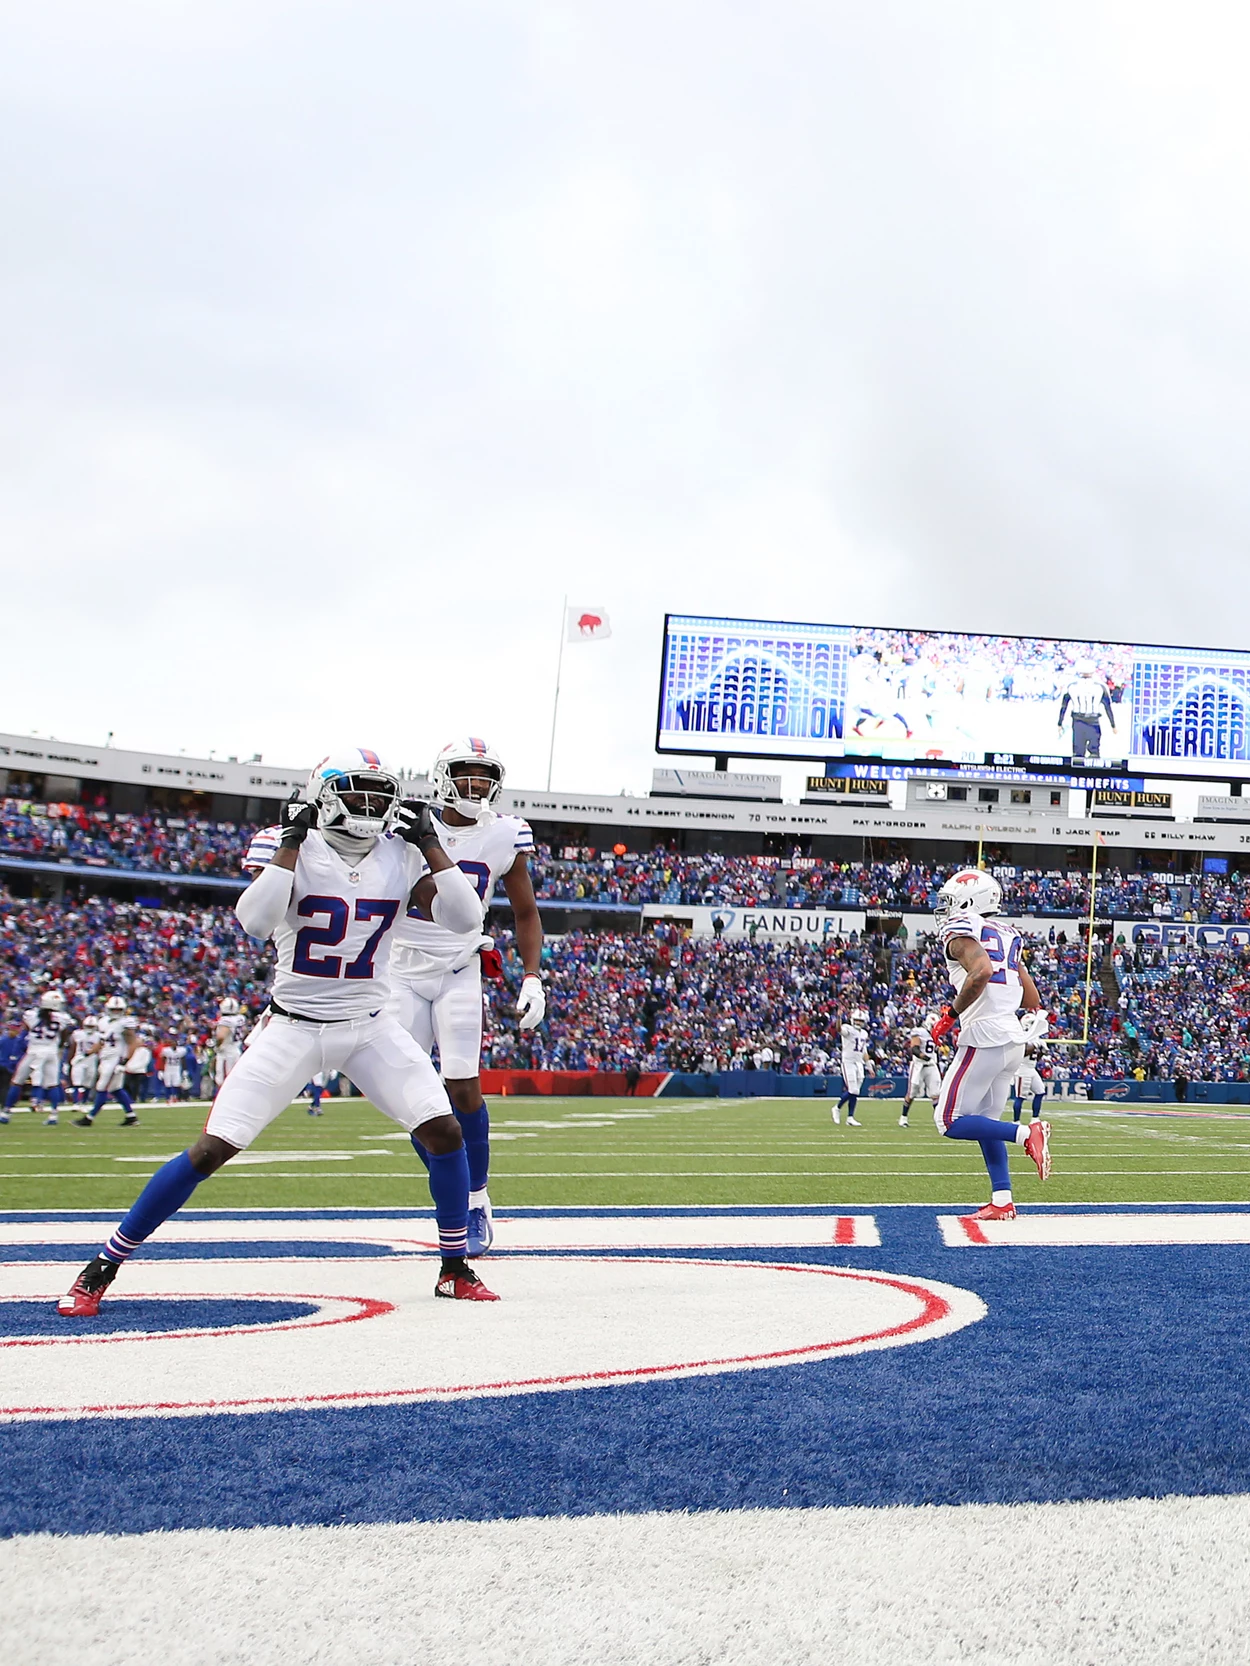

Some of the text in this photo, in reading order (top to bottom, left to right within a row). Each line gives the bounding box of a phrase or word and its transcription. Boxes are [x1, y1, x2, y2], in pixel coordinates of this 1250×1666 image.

[688, 771, 779, 783] IMAGINE STAFFING
[810, 778, 885, 790] HUNT HUNT
[1071, 778, 1130, 790] BENEFITS
[1098, 792, 1170, 804] HUNT HUNT
[749, 814, 761, 822] 70
[743, 914, 849, 933] FANDUEL
[292, 894, 401, 978] 27
[854, 1038, 864, 1052] 17
